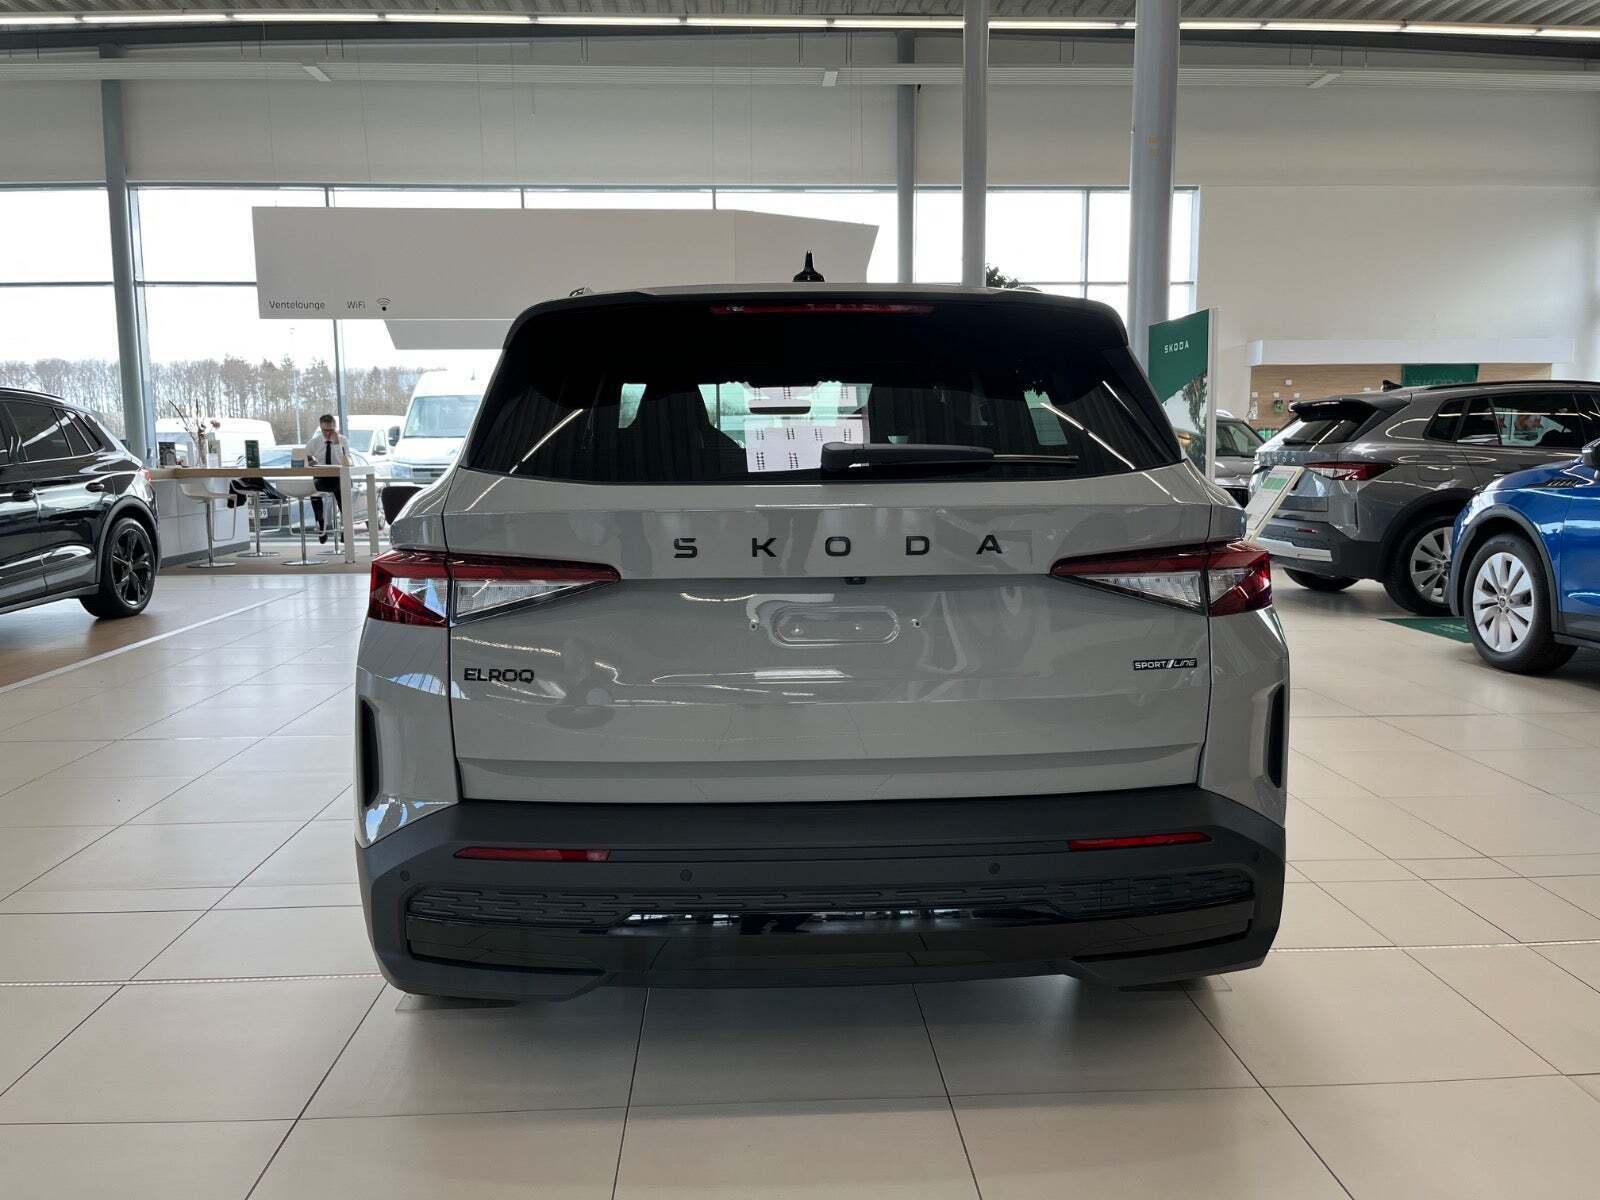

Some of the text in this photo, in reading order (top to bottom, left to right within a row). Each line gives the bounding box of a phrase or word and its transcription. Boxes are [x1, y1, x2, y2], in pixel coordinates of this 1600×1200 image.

[268, 299, 366, 310] Ventelounge WiFi
[463, 667, 535, 684] ELROQ
